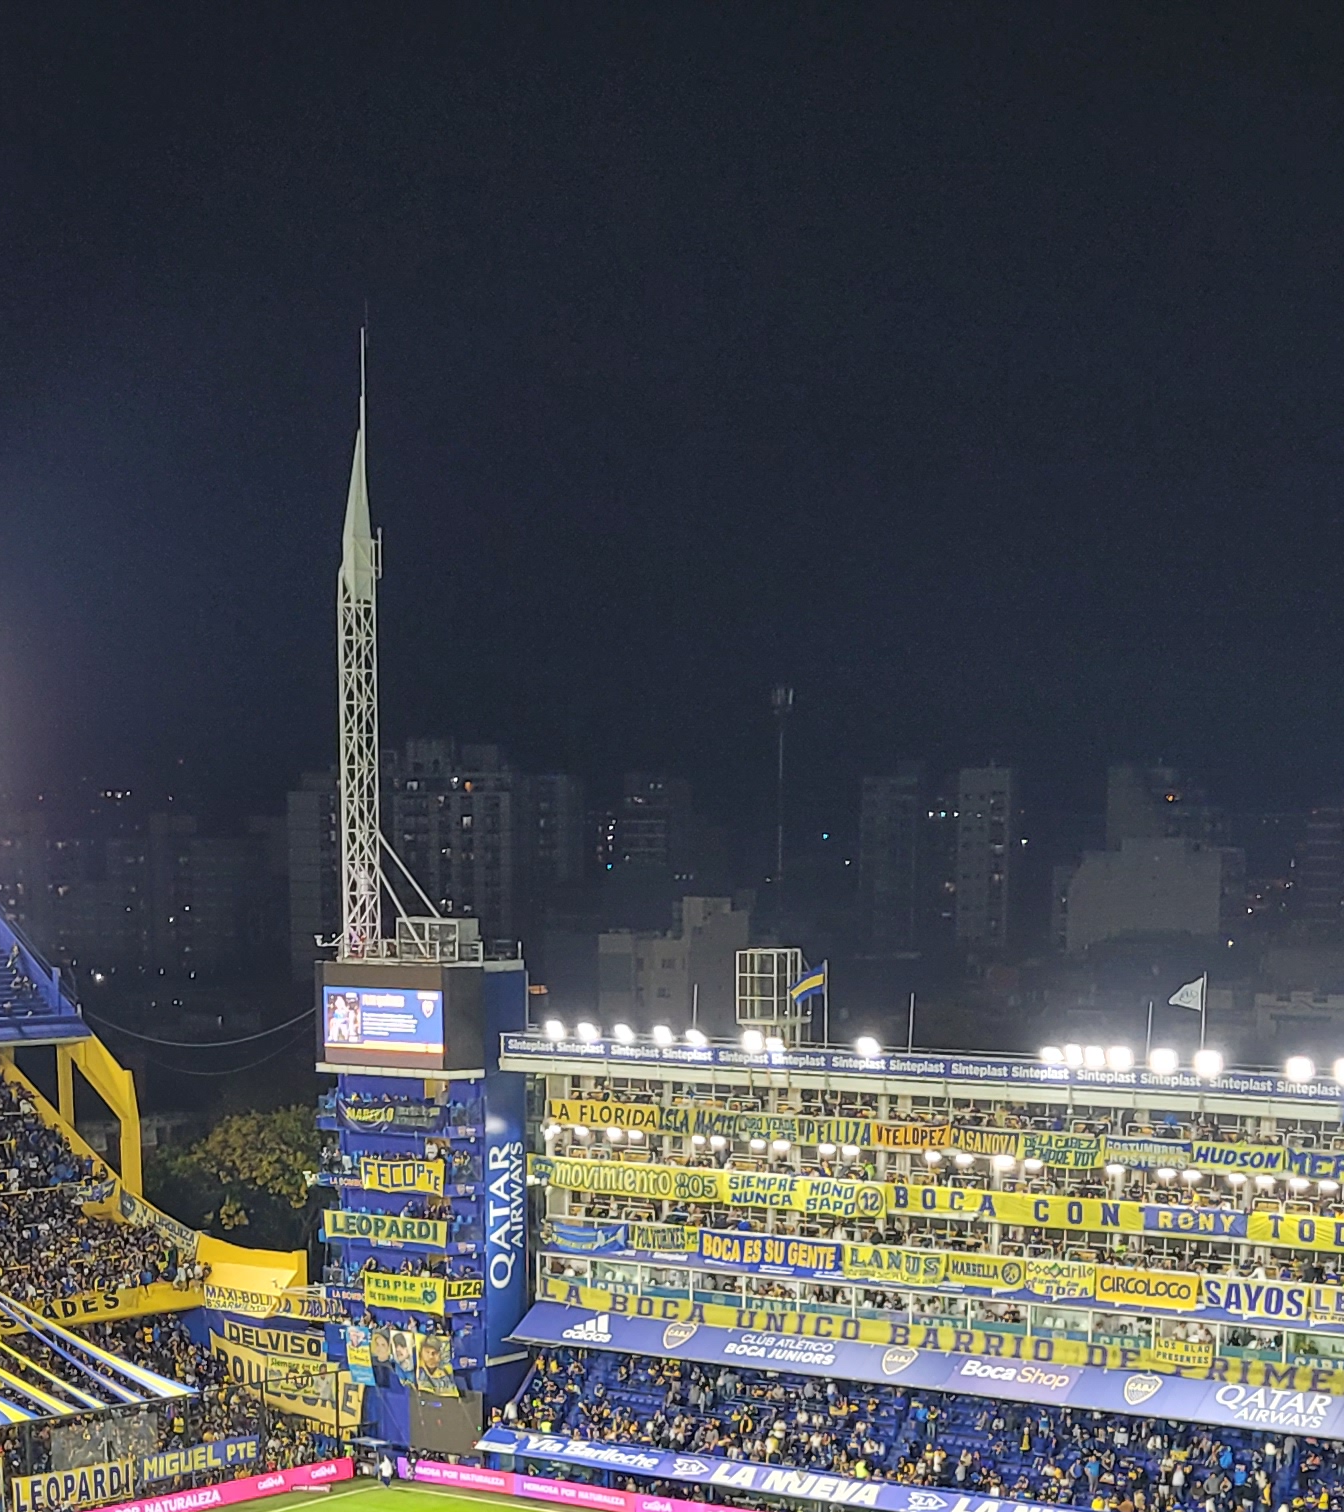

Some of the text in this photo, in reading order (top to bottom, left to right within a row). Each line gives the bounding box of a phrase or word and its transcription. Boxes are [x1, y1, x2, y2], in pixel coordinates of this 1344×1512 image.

[507, 1038, 1008, 1079] Sinteplast Sinteplast Sinteplast Sinteplast Sinteplast Sinteplast Sinteplast Sinteplast
[580, 1105, 656, 1129] FLORIDA
[658, 1107, 689, 1133] ISLA
[806, 1120, 871, 1146] PELLIZA
[905, 1126, 947, 1147] LOPEZ
[950, 1129, 1019, 1155] CASANOVA
[1195, 1150, 1282, 1168] HUDSON
[364, 1162, 416, 1188] FECO
[556, 1160, 718, 1200] movimiento 805
[729, 1176, 799, 1192] SIEMPRE
[510, 1142, 524, 1248] AIRWAYS
[731, 1192, 793, 1206] NUNCA
[809, 1181, 855, 1200] MONO
[860, 1191, 879, 1210] 12
[489, 1144, 516, 1289] QATAR
[806, 1197, 855, 1216] SAPO
[893, 1186, 1121, 1226] BOCA CON
[332, 1214, 438, 1241] LEOPARDI
[1158, 1210, 1236, 1232] RONY
[703, 1234, 836, 1270] BOCA ES SU GENTE
[850, 1247, 940, 1276] LANUS
[951, 1260, 999, 1279] MARBELLA
[447, 1281, 482, 1297] LIZA
[1099, 1274, 1192, 1302] CIRCOLOCO
[1203, 1279, 1304, 1318] SAYOS
[228, 1323, 321, 1357] DELVISO
[562, 1329, 612, 1343] adidas
[736, 1308, 1141, 1369] UNICO BARRIO DE
[741, 1334, 835, 1352] CLUB ATLÉTICO
[1157, 1338, 1176, 1347] LOS
[725, 1342, 835, 1366] BOCA JUNIORS
[1157, 1351, 1209, 1364] PRESENTES
[961, 1360, 1069, 1391] Boca Shop
[1215, 1384, 1333, 1416] QATAR
[1235, 1405, 1323, 1429] AIRWAYS
[144, 1439, 257, 1480] MIGUEL PTE
[566, 1439, 660, 1471] Bariloche
[710, 1462, 756, 1487] LA
[762, 1471, 882, 1505] NUEVA
[459, 1472, 505, 1486] NATURALEZA
[524, 1482, 625, 1507] HERMOSA NATURALEZA
